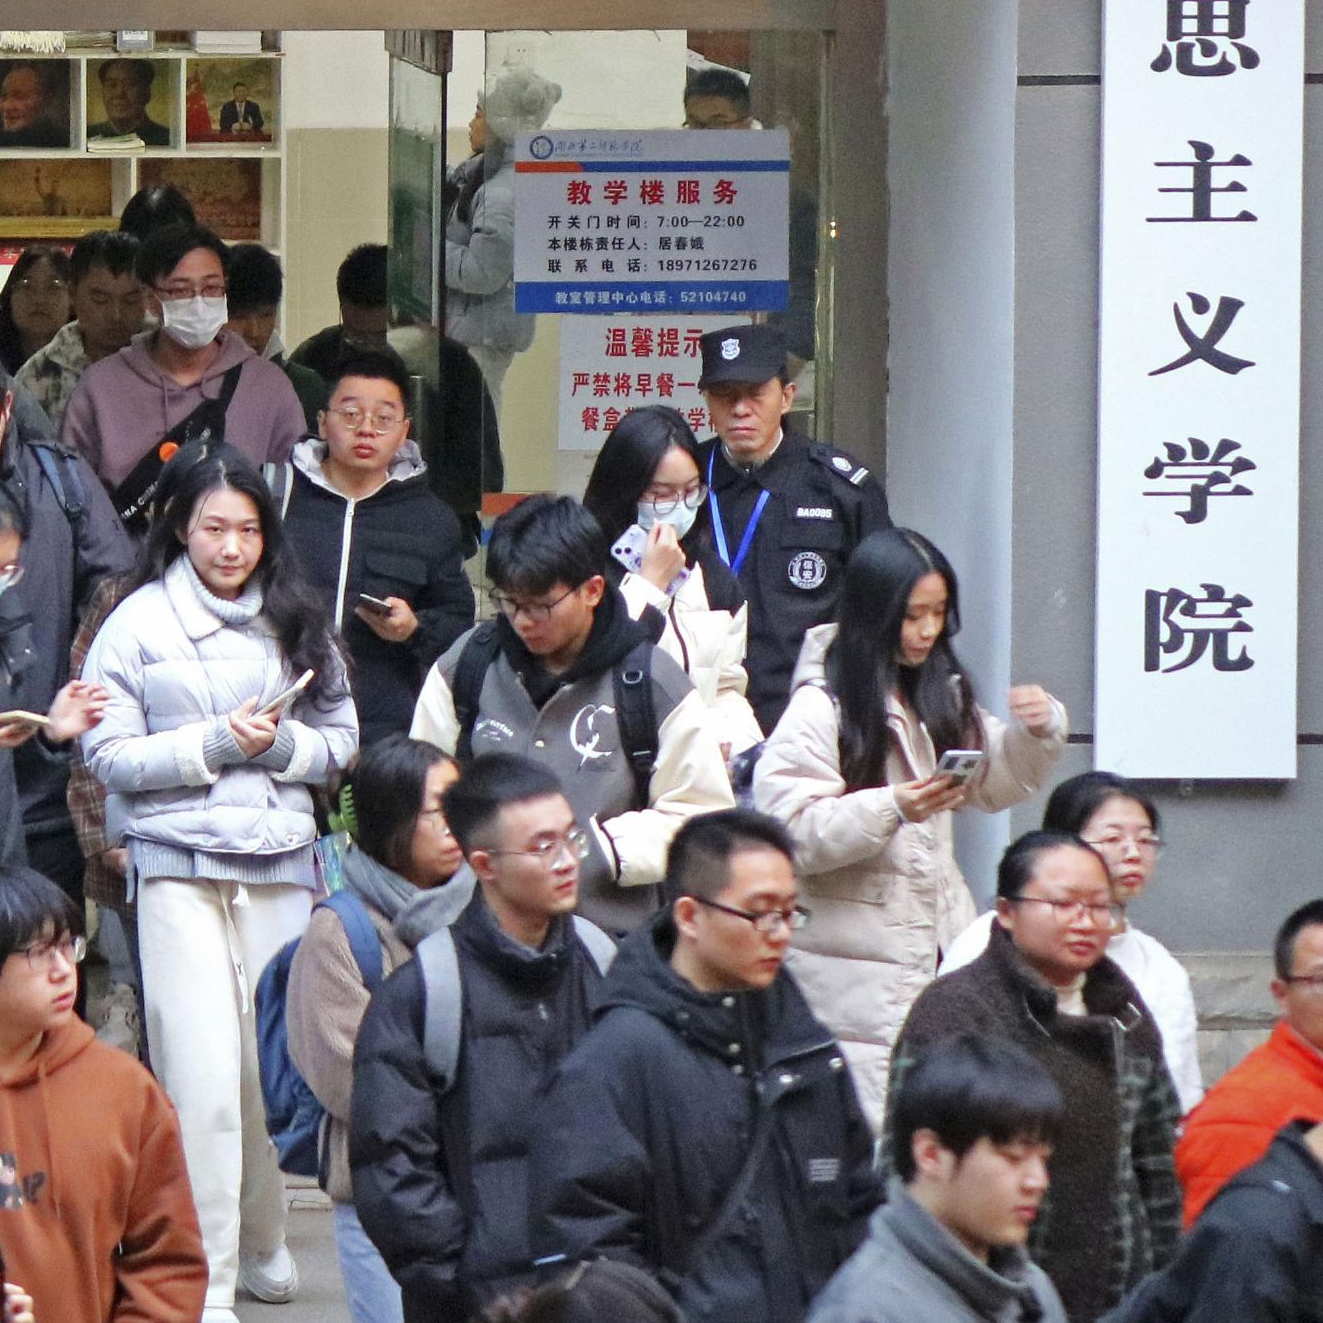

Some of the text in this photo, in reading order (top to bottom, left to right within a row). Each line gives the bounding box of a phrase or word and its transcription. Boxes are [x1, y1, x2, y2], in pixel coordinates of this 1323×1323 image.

[566, 179, 739, 206] 教学楼服务
[605, 327, 703, 358] 温馨提示
[571, 372, 705, 398] 严禁将早餐一
